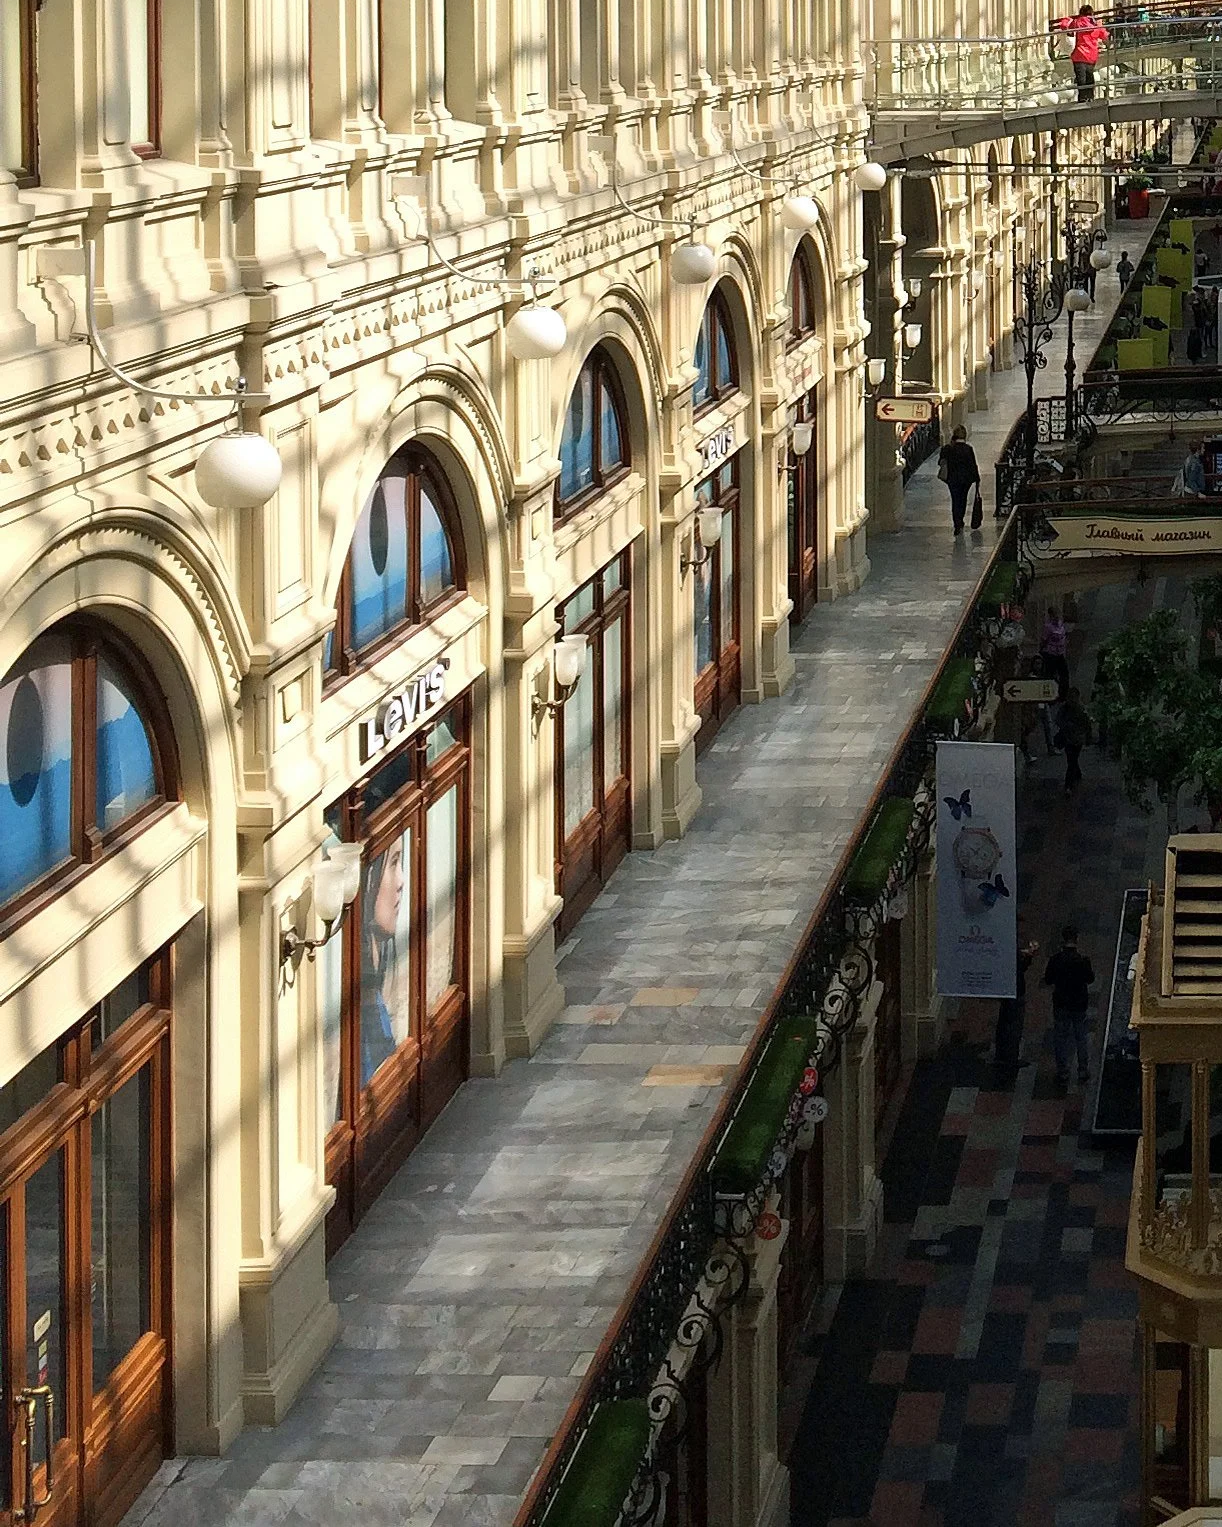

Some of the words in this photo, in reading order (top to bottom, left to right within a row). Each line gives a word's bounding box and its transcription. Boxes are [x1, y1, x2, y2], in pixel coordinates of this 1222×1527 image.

[1086, 523, 1145, 542] Главный
[1150, 530, 1211, 542] магазин
[359, 663, 446, 766] Levi's
